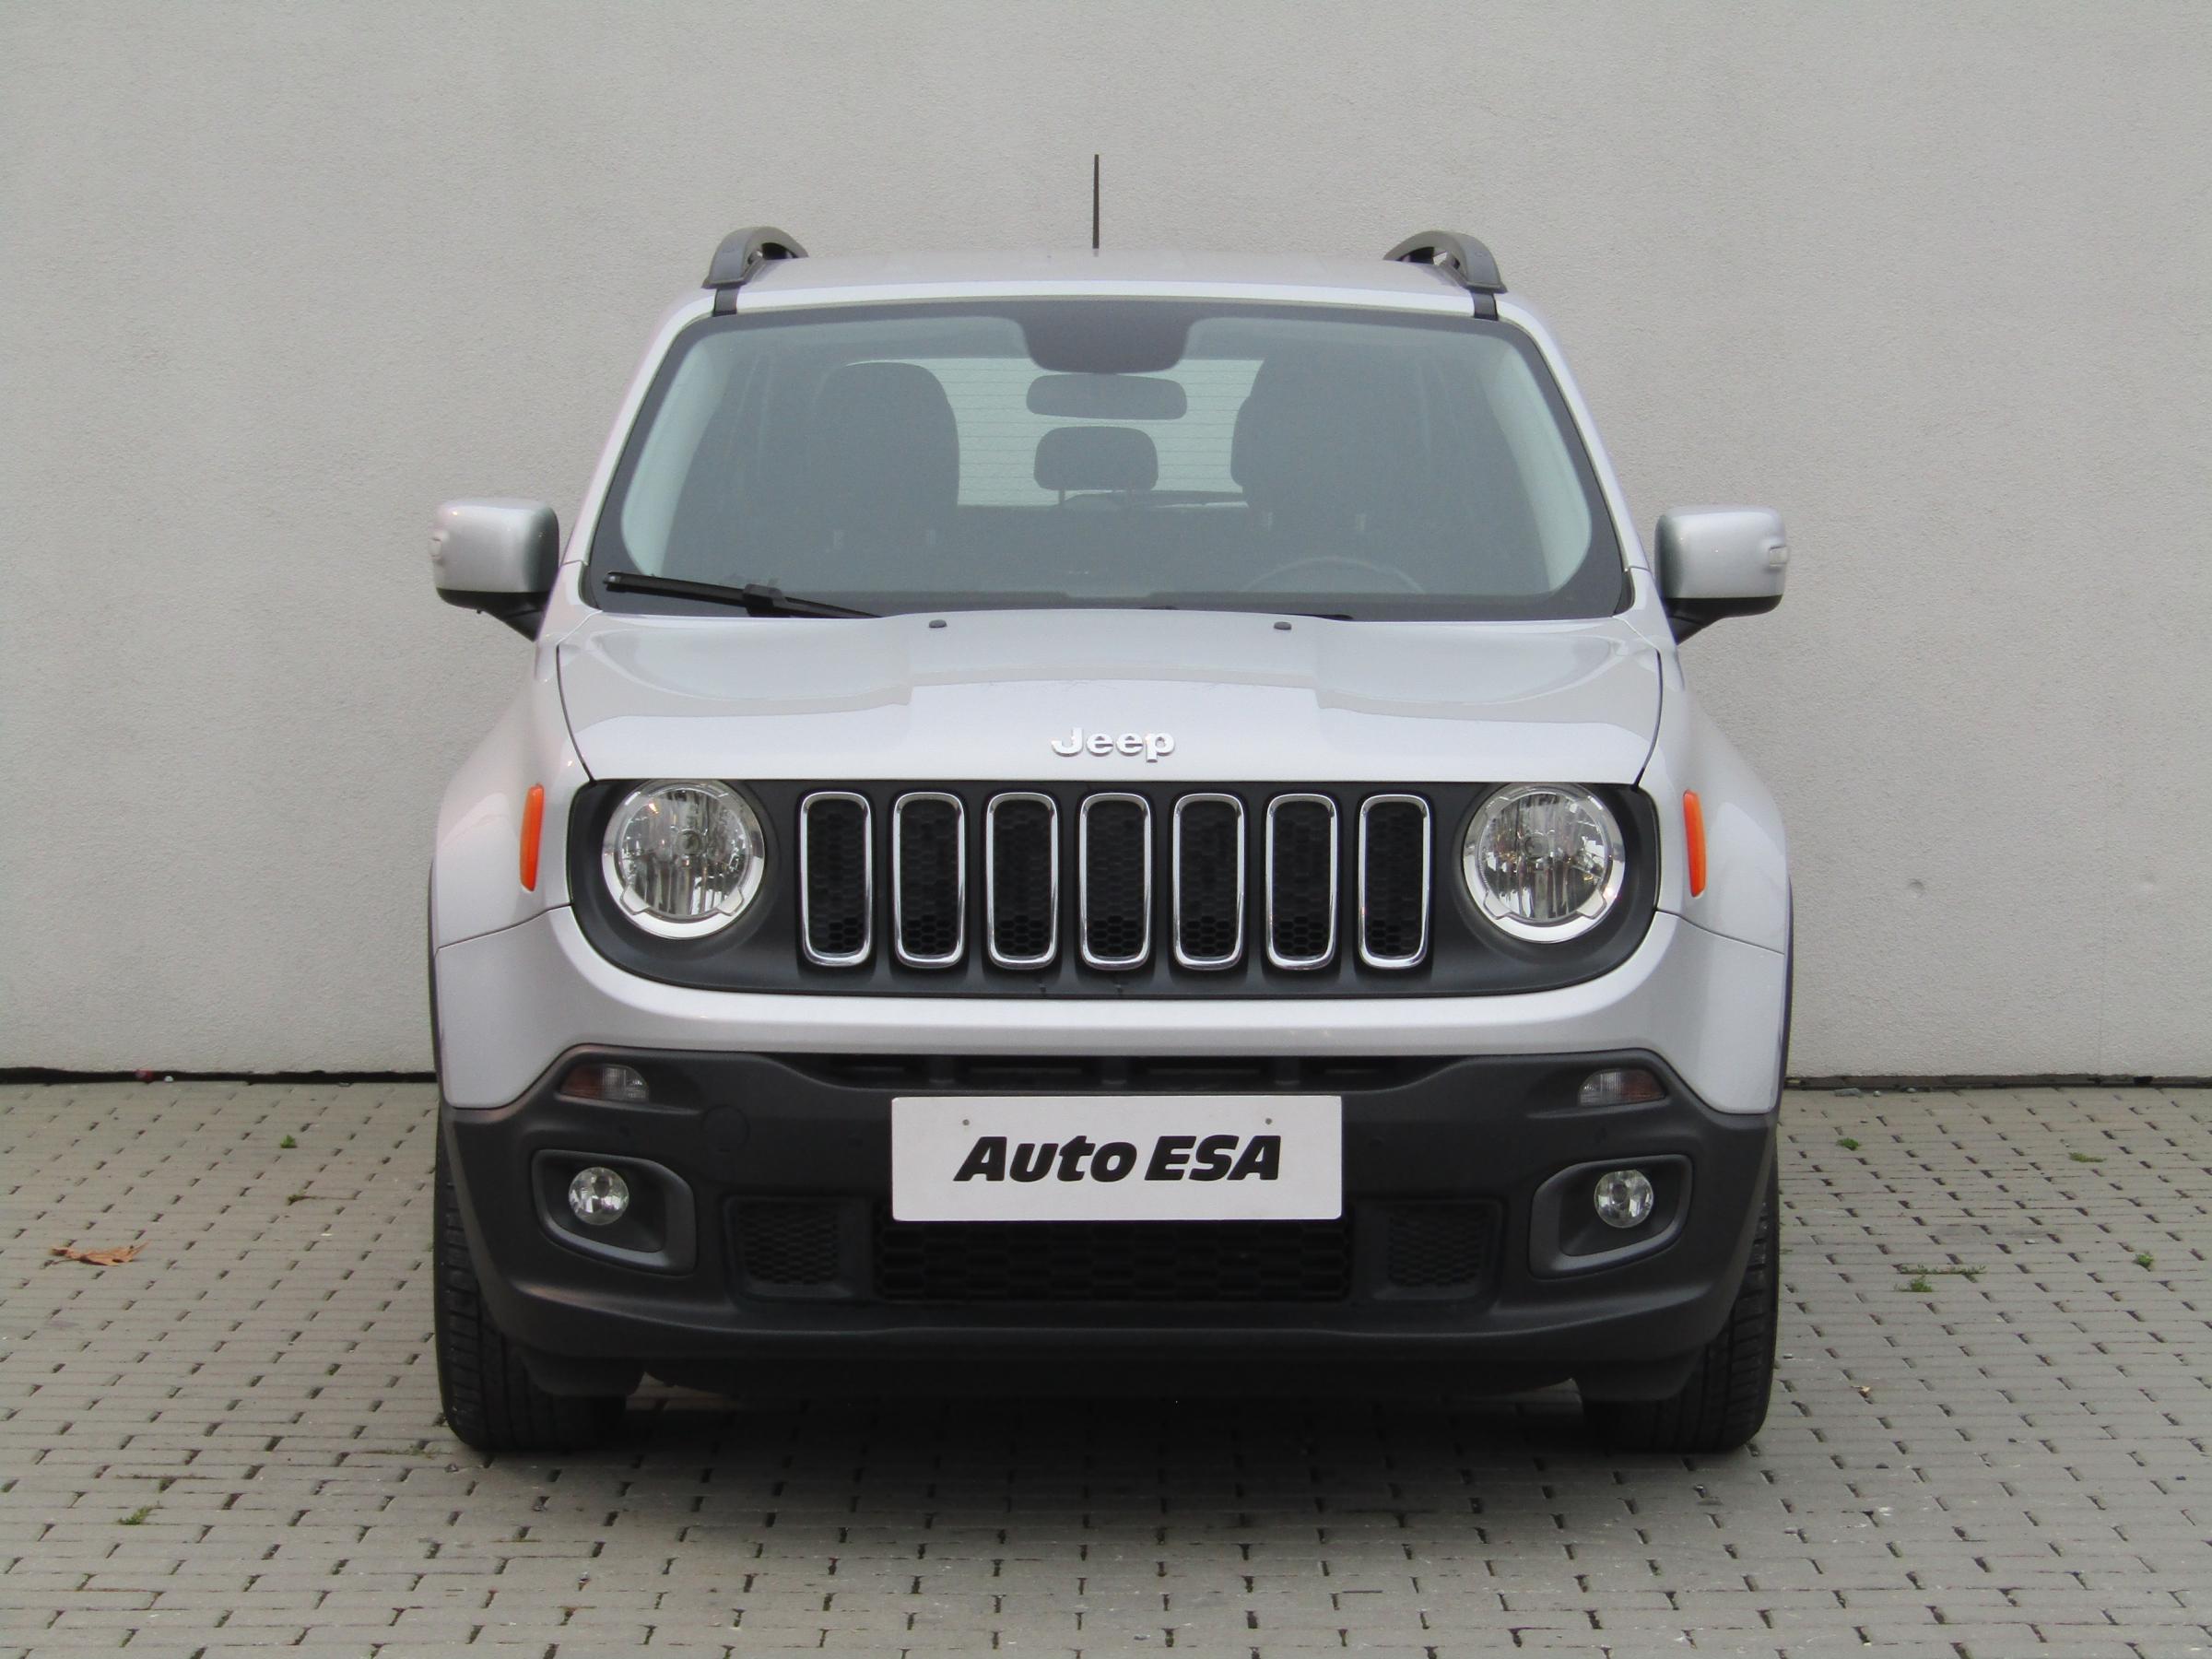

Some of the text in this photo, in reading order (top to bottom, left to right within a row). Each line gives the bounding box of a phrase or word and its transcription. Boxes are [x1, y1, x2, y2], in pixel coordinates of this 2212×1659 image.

[1051, 726, 1175, 762] Jeep
[953, 1135, 1281, 1182] Auto ESA
